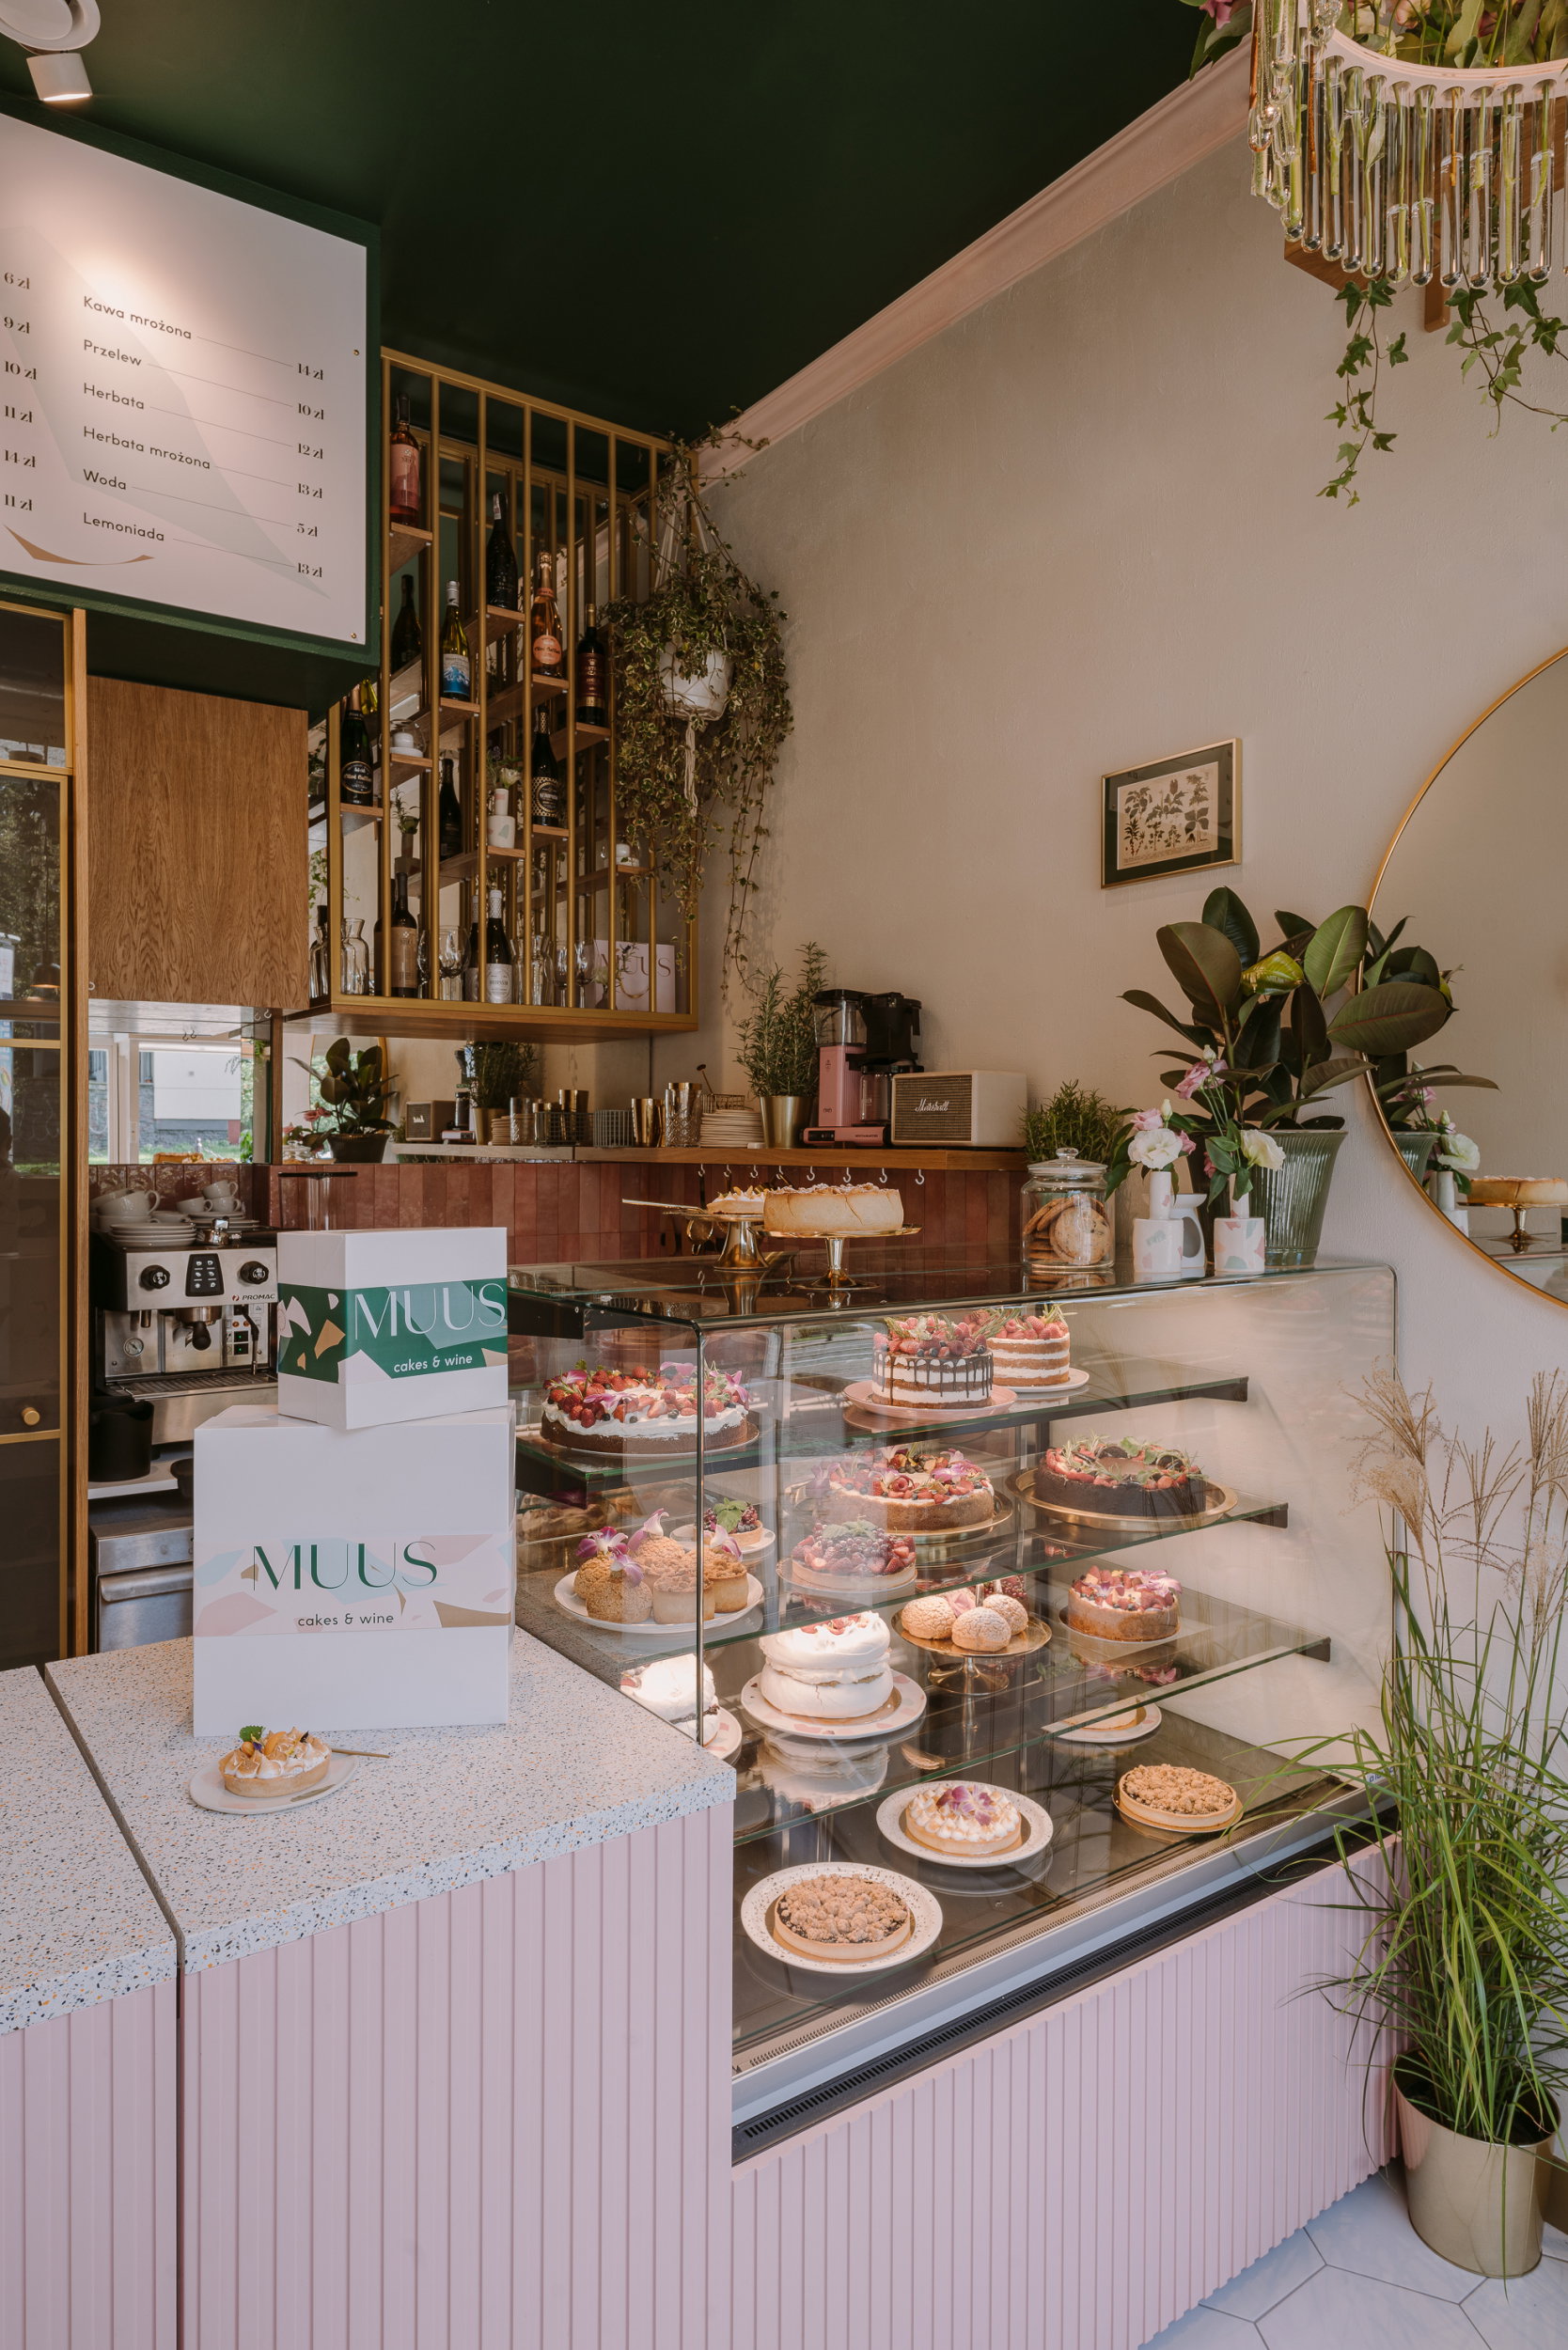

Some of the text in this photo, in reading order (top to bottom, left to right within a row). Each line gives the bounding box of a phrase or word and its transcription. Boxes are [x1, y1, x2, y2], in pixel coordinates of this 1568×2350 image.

[4, 272, 30, 290] 6 zł
[3, 316, 30, 335] 9 zł
[84, 295, 324, 381] Kawa mrożona 14 zł
[5, 360, 37, 381] 10 zł
[83, 338, 324, 420] Przelew 10 zł
[5, 405, 33, 424] 11 zł
[84, 382, 323, 460] Herbata 12 zł
[5, 449, 36, 468] 14 zł
[83, 425, 322, 499] Herbata mrożona 13 zł
[4, 494, 33, 511] 11 zł
[83, 468, 318, 538] Woda 5 zł
[83, 511, 322, 578] Lemoniada 13 zł
[354, 1282, 506, 1341] MUUS
[393, 1353, 474, 1373] cakes & wine
[253, 1540, 438, 1591] MUUS
[297, 1611, 395, 1628] cakes & wine
